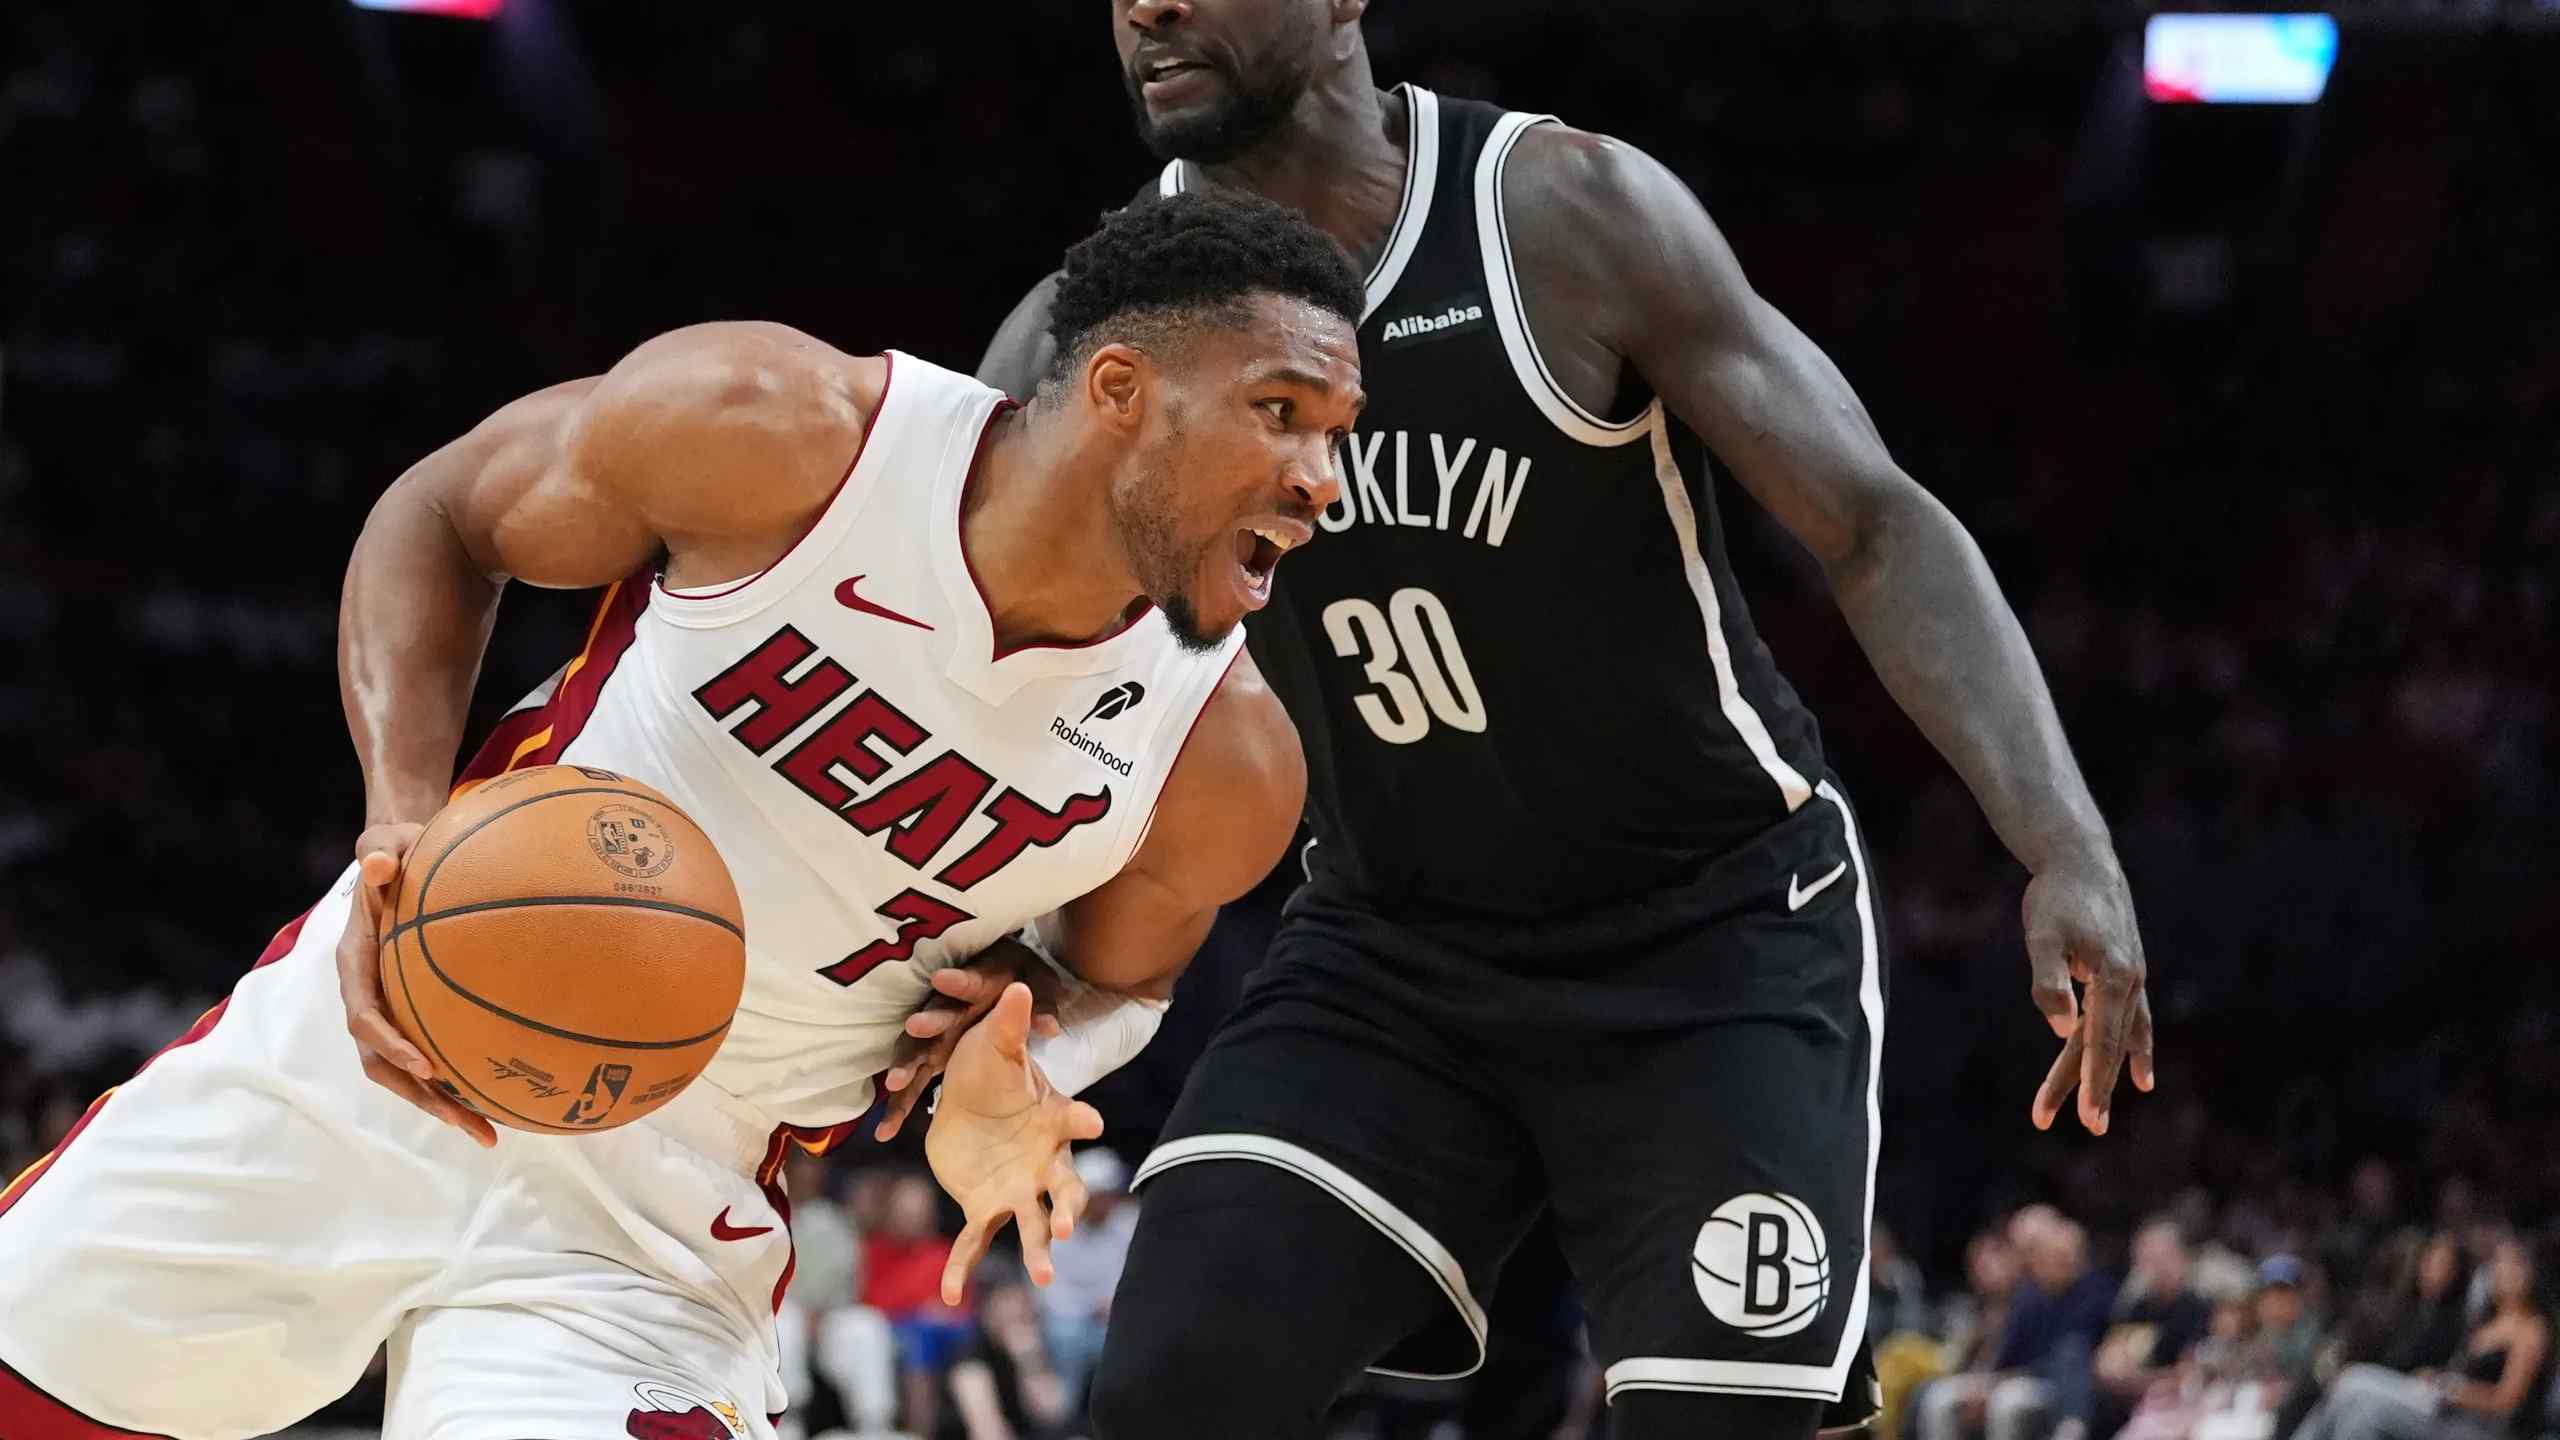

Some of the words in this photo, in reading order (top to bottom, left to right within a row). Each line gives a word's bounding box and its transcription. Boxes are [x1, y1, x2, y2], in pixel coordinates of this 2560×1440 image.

[1383, 305, 1483, 343] Alibaba
[1322, 587, 1487, 744] 30
[691, 623, 1112, 892] HEAT
[1050, 716, 1134, 777] Robinhood
[814, 887, 978, 987] 7
[1744, 1212, 1791, 1316] B
